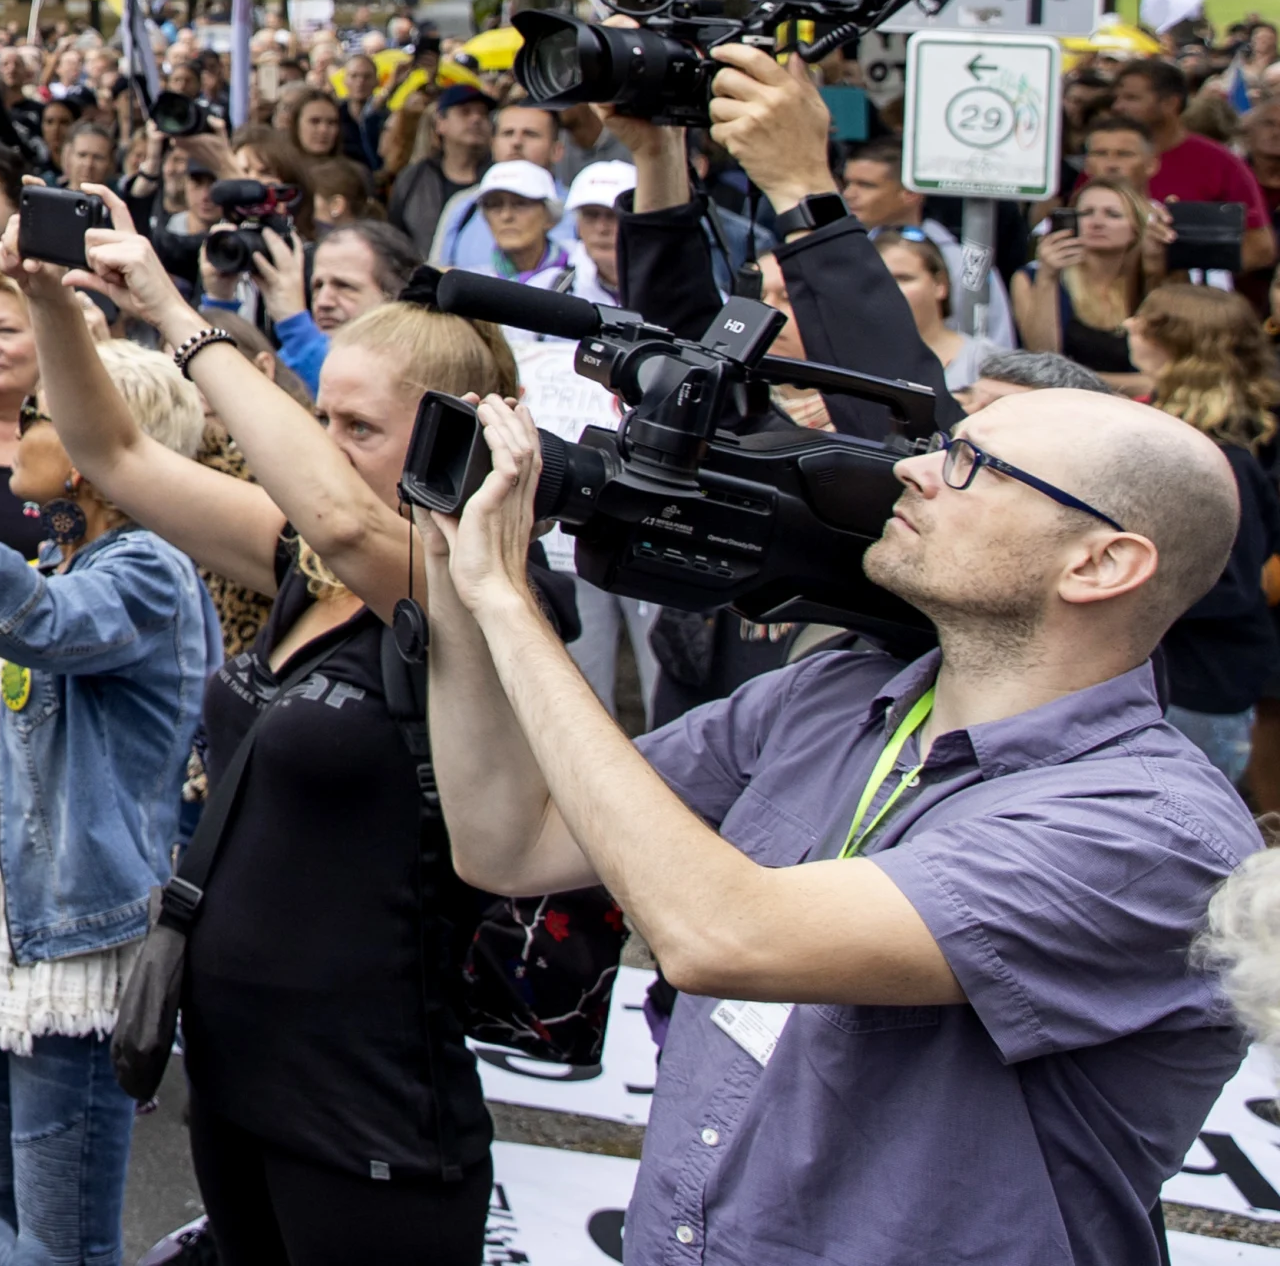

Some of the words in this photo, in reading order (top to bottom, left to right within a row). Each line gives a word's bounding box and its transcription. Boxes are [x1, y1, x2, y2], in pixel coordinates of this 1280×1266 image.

[958, 103, 1002, 131] 29
[724, 318, 746, 334] HD
[582, 353, 603, 367] SONY
[581, 486, 592, 496] G
